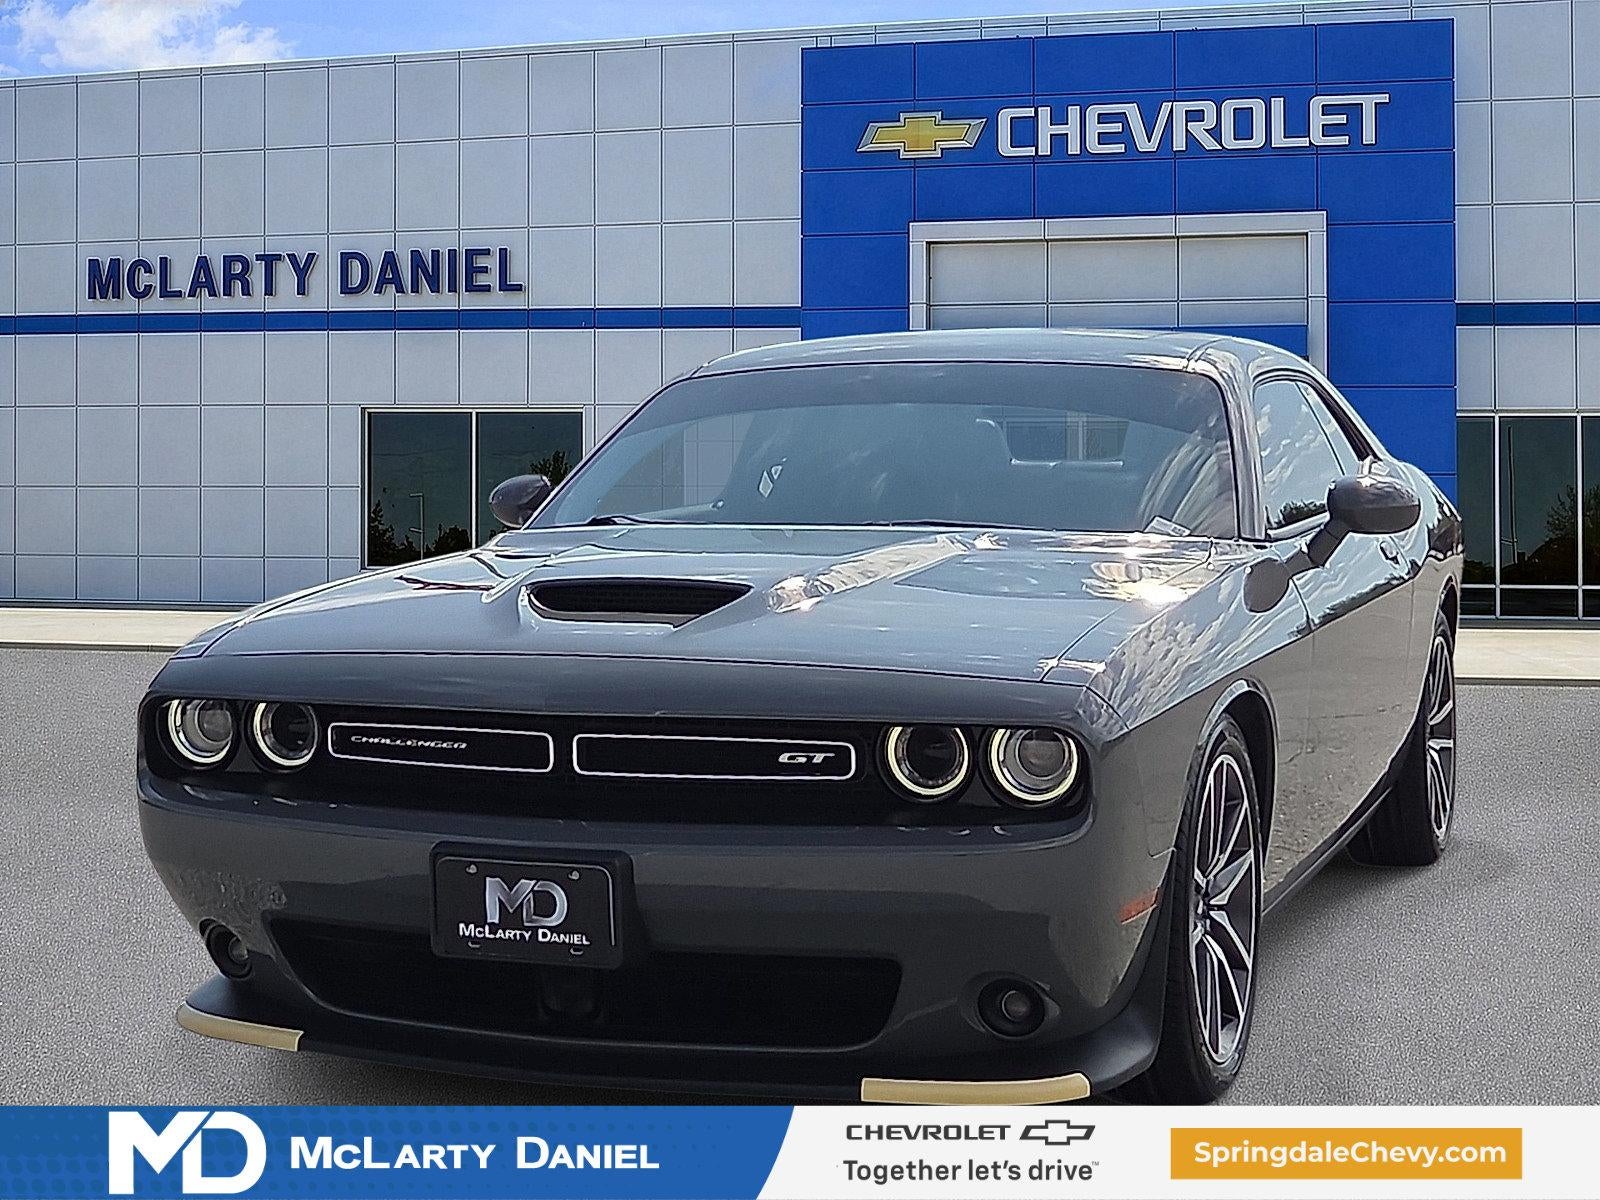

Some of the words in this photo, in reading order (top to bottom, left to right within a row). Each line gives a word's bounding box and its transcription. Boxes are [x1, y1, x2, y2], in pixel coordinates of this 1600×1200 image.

[996, 93, 1390, 158] CHEVROLET
[338, 246, 525, 296] DANIEL
[352, 735, 467, 749] CHALLENGER
[778, 752, 835, 764] GT
